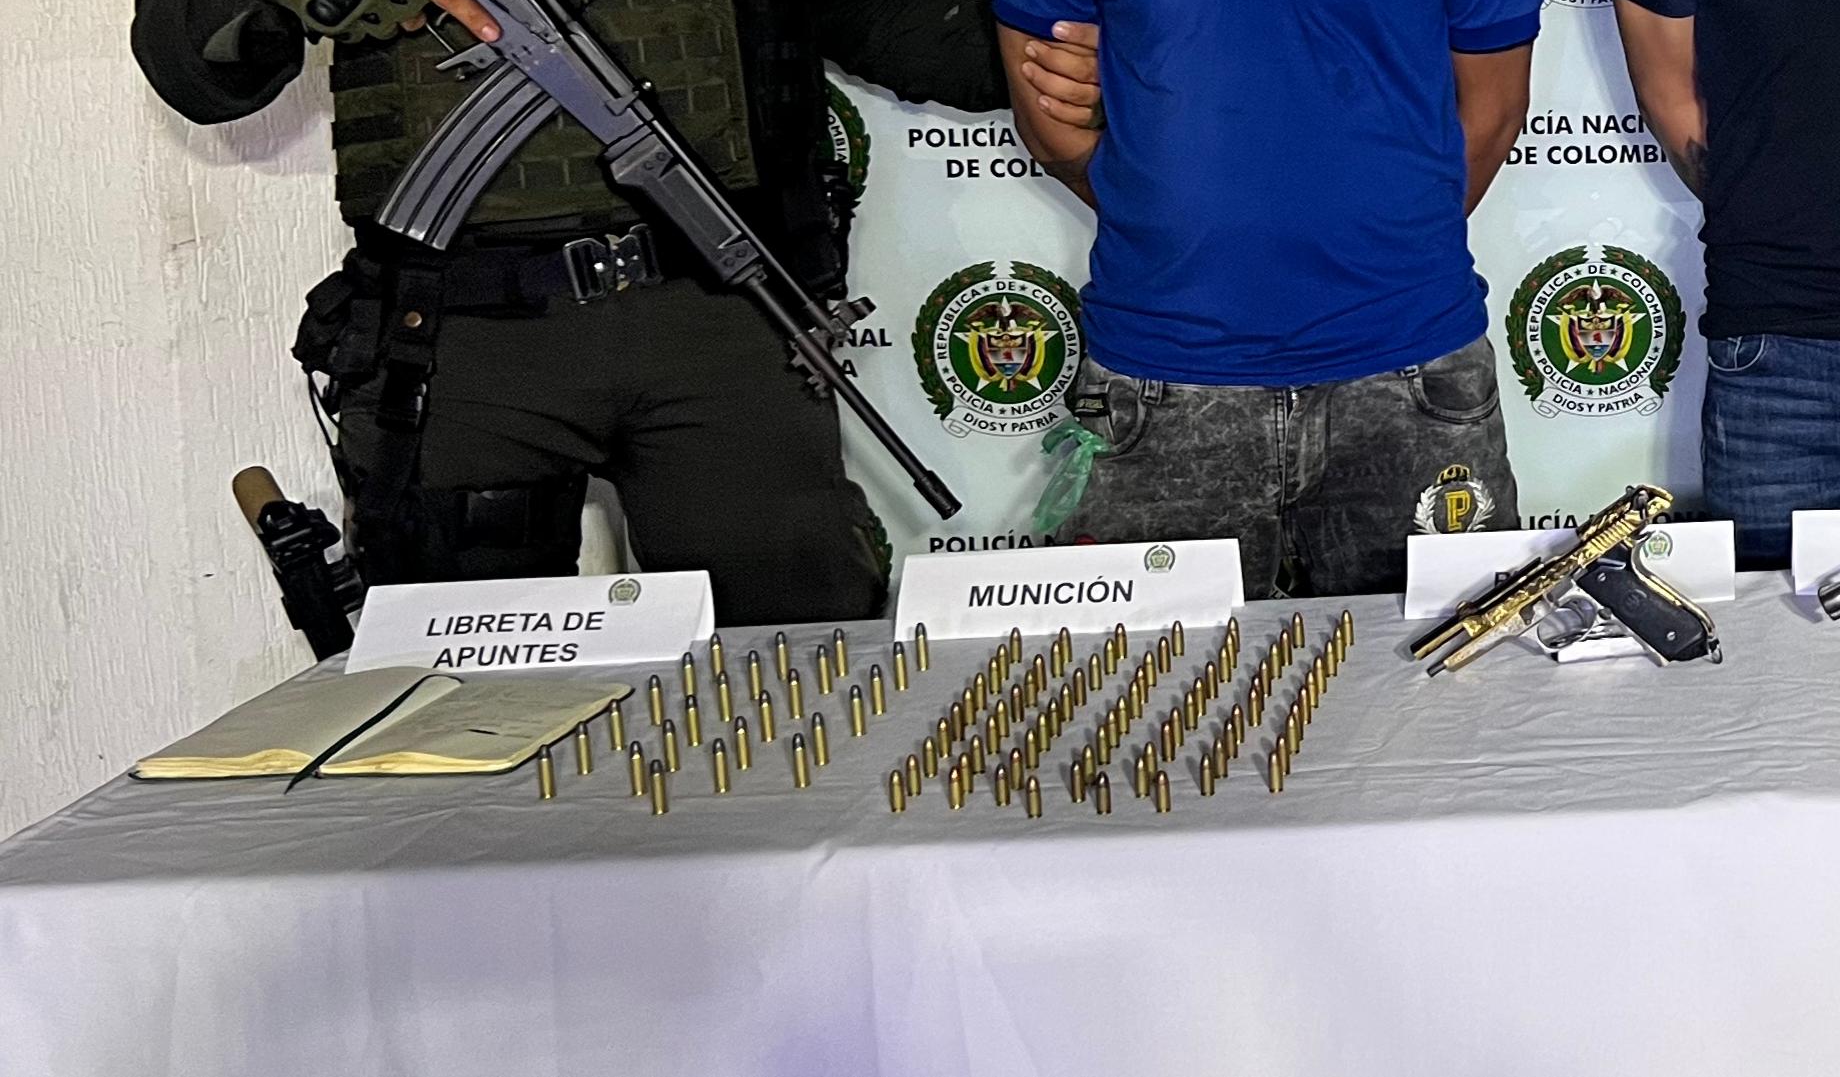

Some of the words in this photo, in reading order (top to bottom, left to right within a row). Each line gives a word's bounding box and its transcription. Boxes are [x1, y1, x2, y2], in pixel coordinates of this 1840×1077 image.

[908, 121, 1016, 147] POLICÍA
[1522, 110, 1573, 135] ICÍA
[1582, 114, 1644, 135] NACI
[947, 159, 979, 178] DE
[1507, 147, 1537, 166] DE
[1547, 145, 1667, 166] COLOMBI
[1588, 265, 1606, 274] DE
[1622, 272, 1663, 339] COLOMBIA
[996, 281, 1015, 291] DE
[1032, 288, 1077, 357] COLOMBIA
[1599, 355, 1658, 396] NACIONAL
[1011, 373, 1072, 415] NACIONAL
[1598, 392, 1644, 412] PATRIA
[1011, 411, 1059, 432] PATRIA
[1445, 489, 1471, 531] P
[968, 575, 1134, 607] MUNICIÓN
[426, 612, 553, 636] LIBRETA
[562, 611, 606, 631] DE
[432, 642, 579, 668] APUNTES
